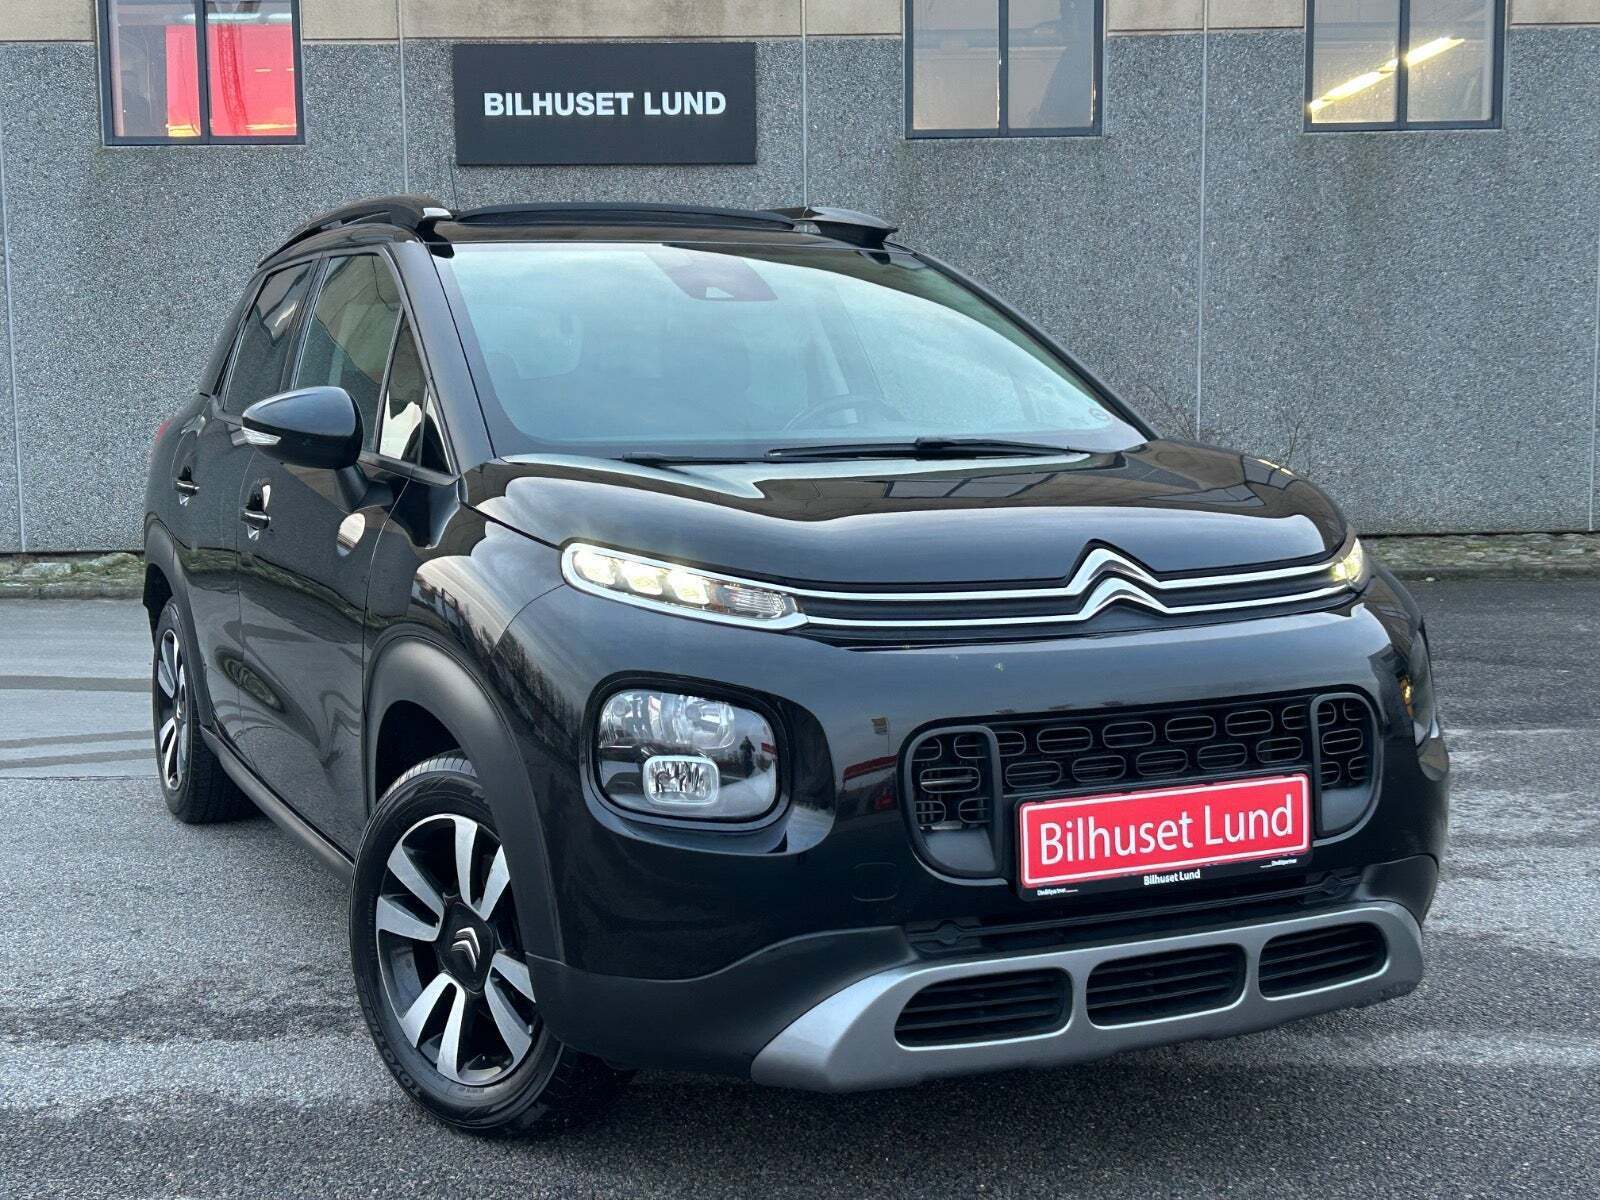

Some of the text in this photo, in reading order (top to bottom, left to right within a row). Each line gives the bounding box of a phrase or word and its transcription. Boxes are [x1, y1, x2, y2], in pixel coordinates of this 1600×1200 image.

[484, 91, 727, 116] BILHUSET LUND
[1039, 793, 1293, 865] Bilhuset Lund
[1143, 869, 1201, 886] Bilhuset Lund
[383, 1047, 423, 1099] TOYO
